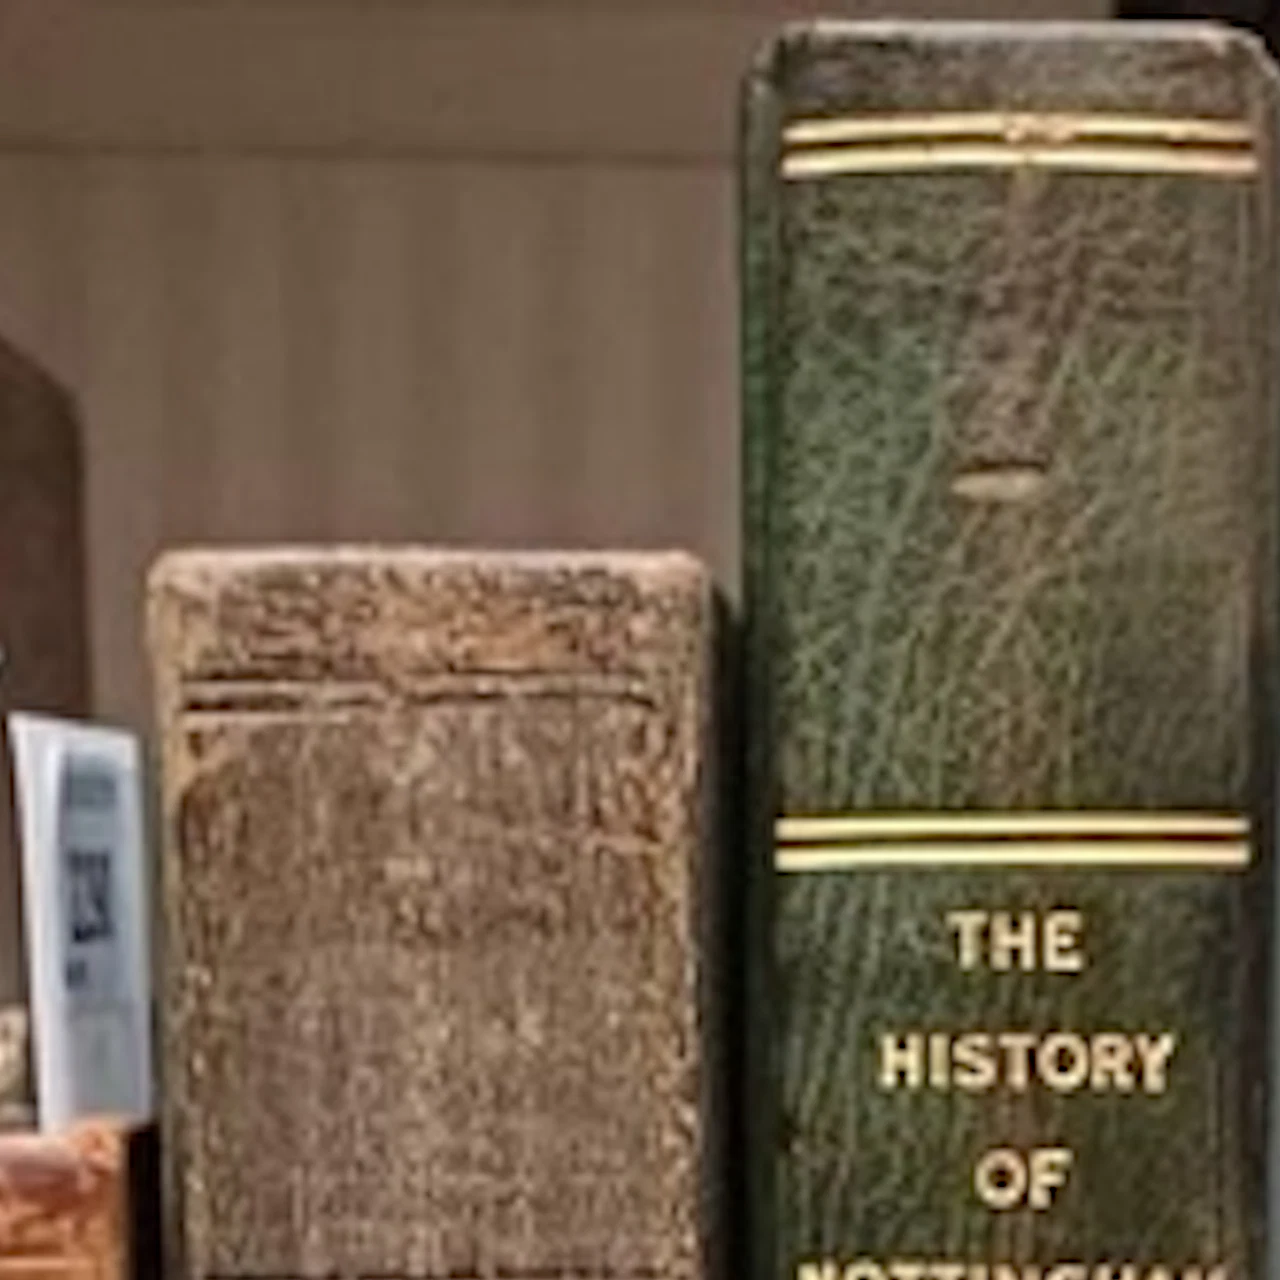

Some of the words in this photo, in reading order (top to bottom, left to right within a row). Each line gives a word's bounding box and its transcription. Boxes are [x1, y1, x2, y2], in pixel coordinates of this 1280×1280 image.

[945, 908, 1086, 973] THE
[877, 1032, 1177, 1094] HISTORY
[972, 1147, 1074, 1211] OF
